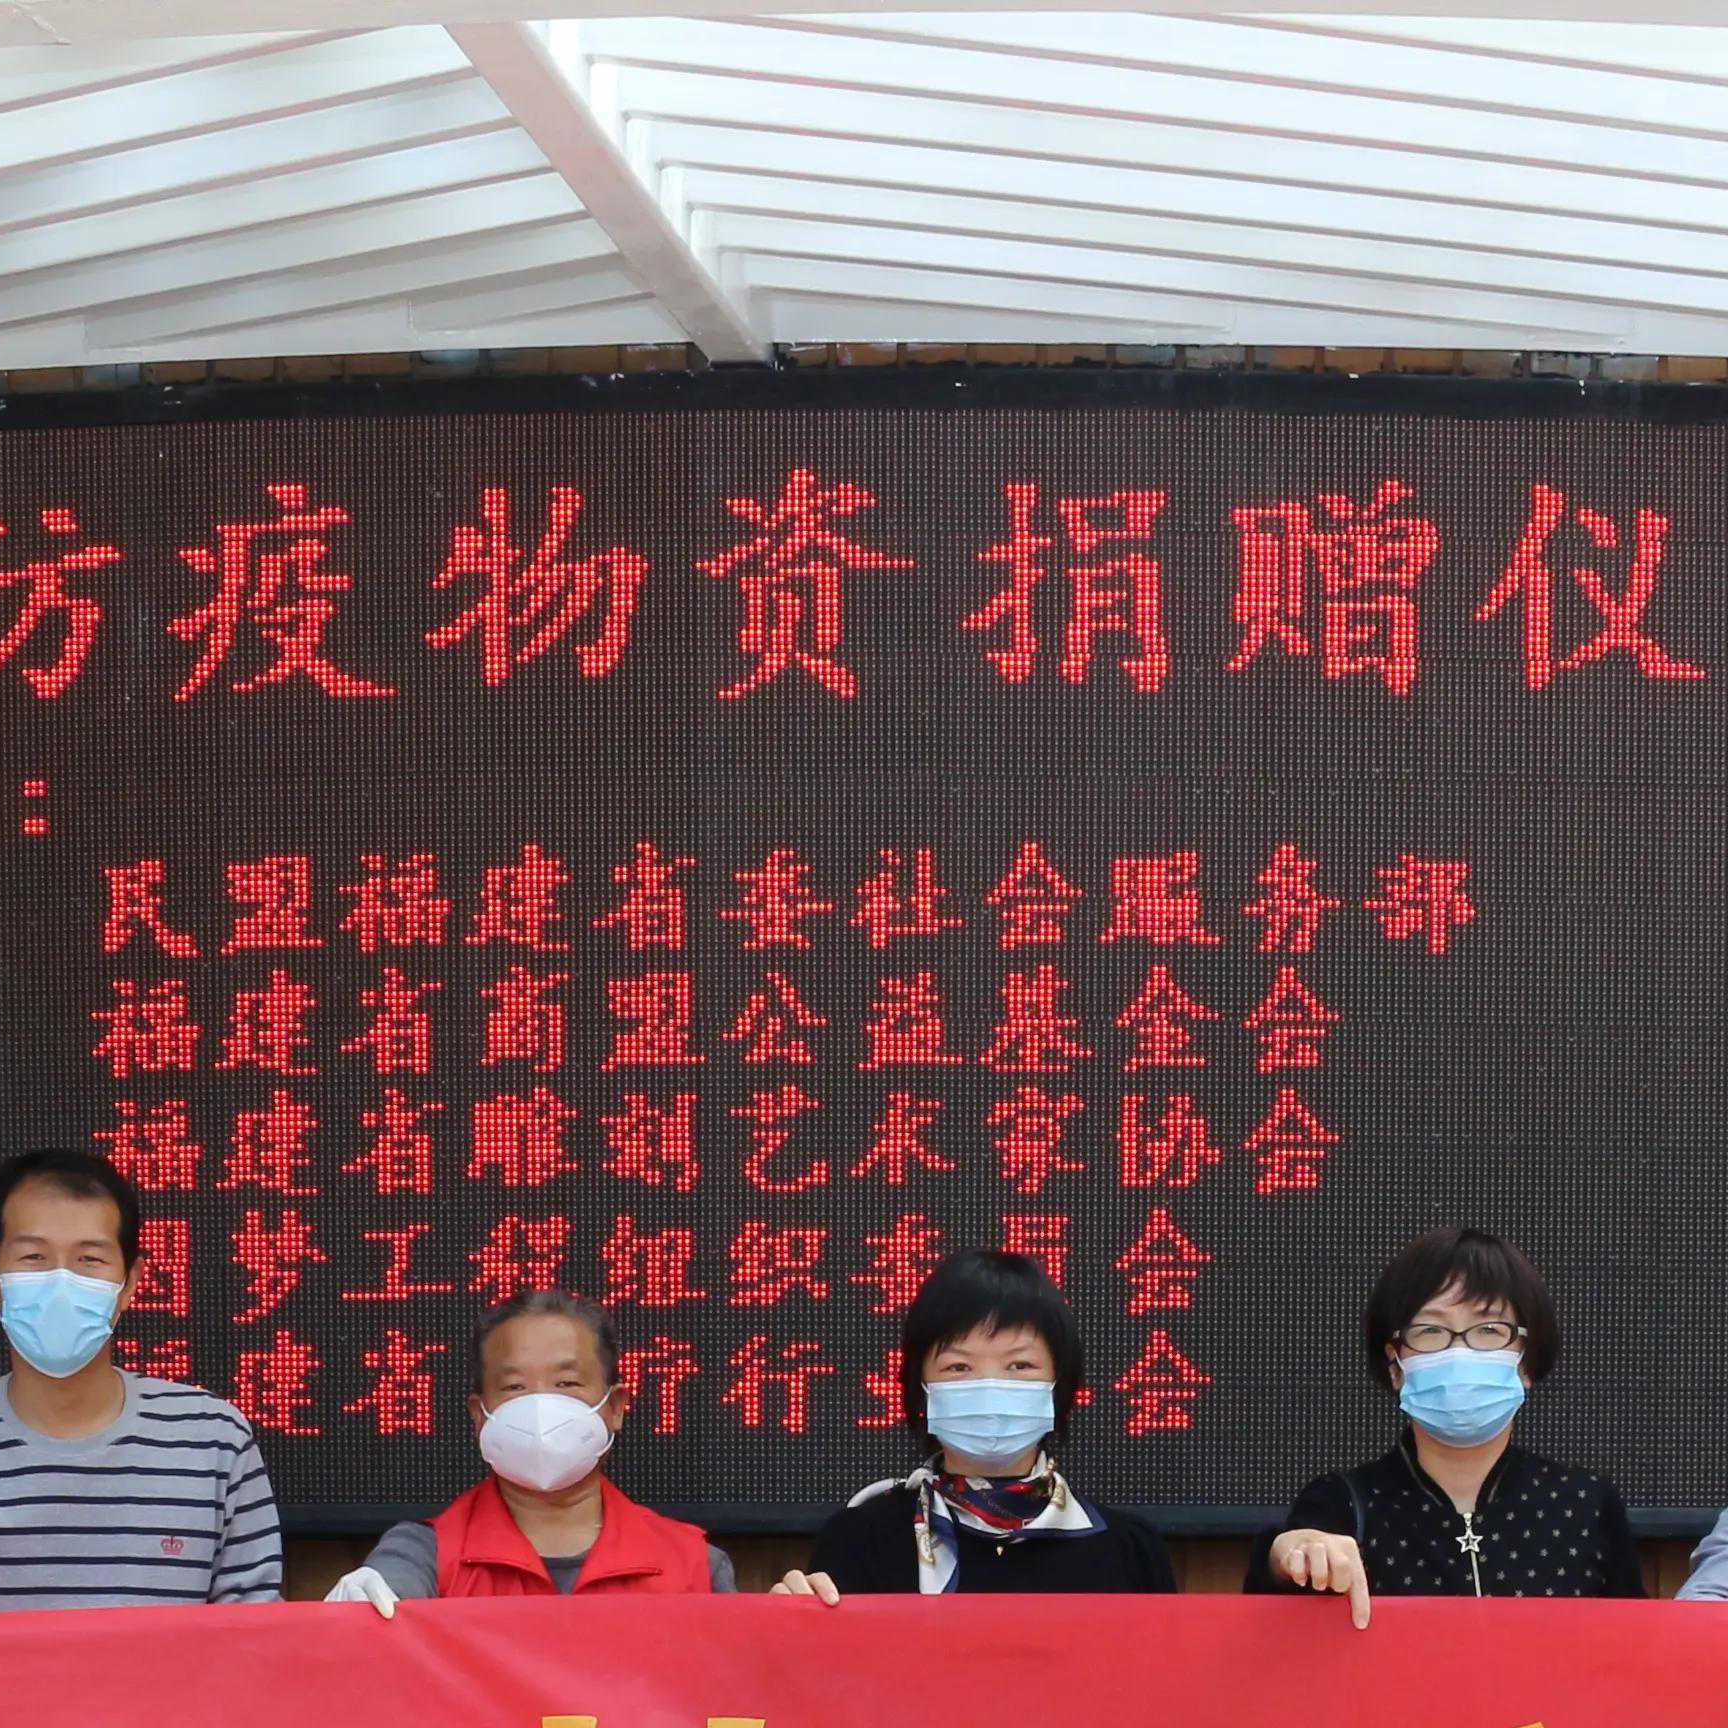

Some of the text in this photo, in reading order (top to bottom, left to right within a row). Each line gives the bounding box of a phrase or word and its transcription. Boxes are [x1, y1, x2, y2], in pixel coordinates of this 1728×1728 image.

[102, 842, 1477, 958] 民盟福建省委社会服务部
[90, 964, 1342, 1079] 福建省商盟公益基金会
[90, 1084, 1342, 1196] 福建省雕刻艺术家协会
